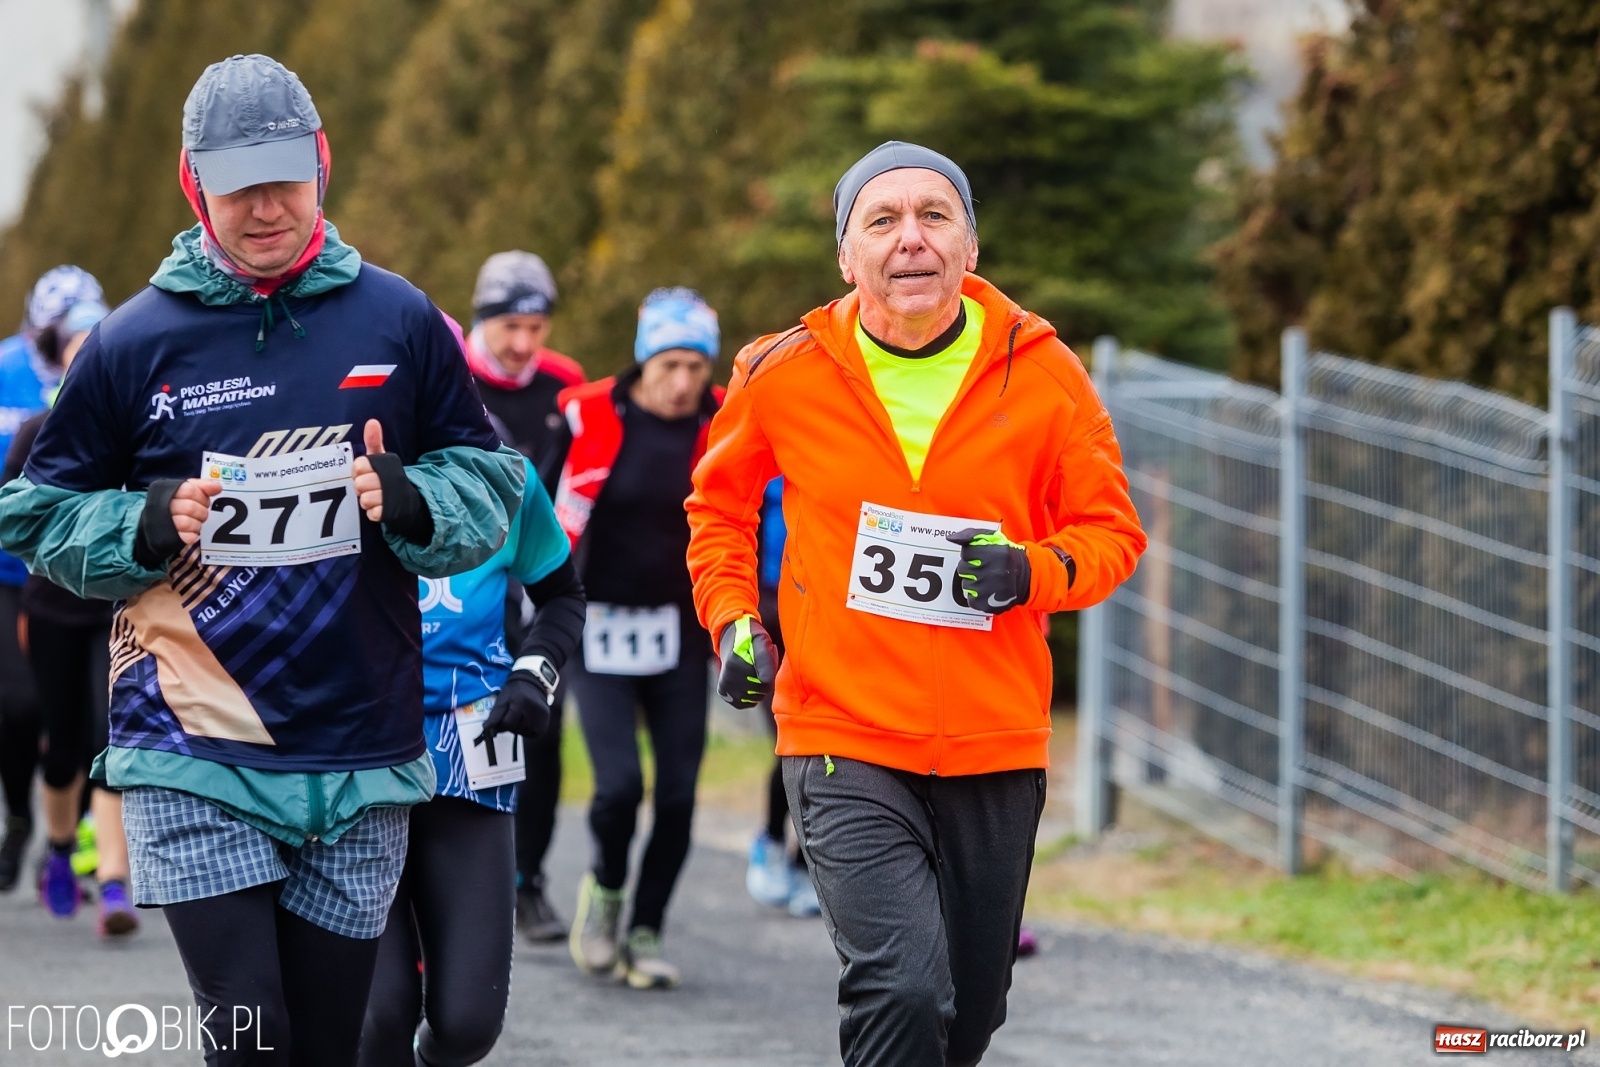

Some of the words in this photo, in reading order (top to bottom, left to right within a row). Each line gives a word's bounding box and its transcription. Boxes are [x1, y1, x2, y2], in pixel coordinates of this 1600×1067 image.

[180, 385, 205, 399] PKO
[206, 376, 252, 394] SILESIA
[182, 384, 276, 410] MARATHON
[253, 456, 348, 479] www.personalbest.pl
[211, 486, 348, 545] 277
[197, 604, 221, 624] 10.
[596, 629, 666, 656] 111
